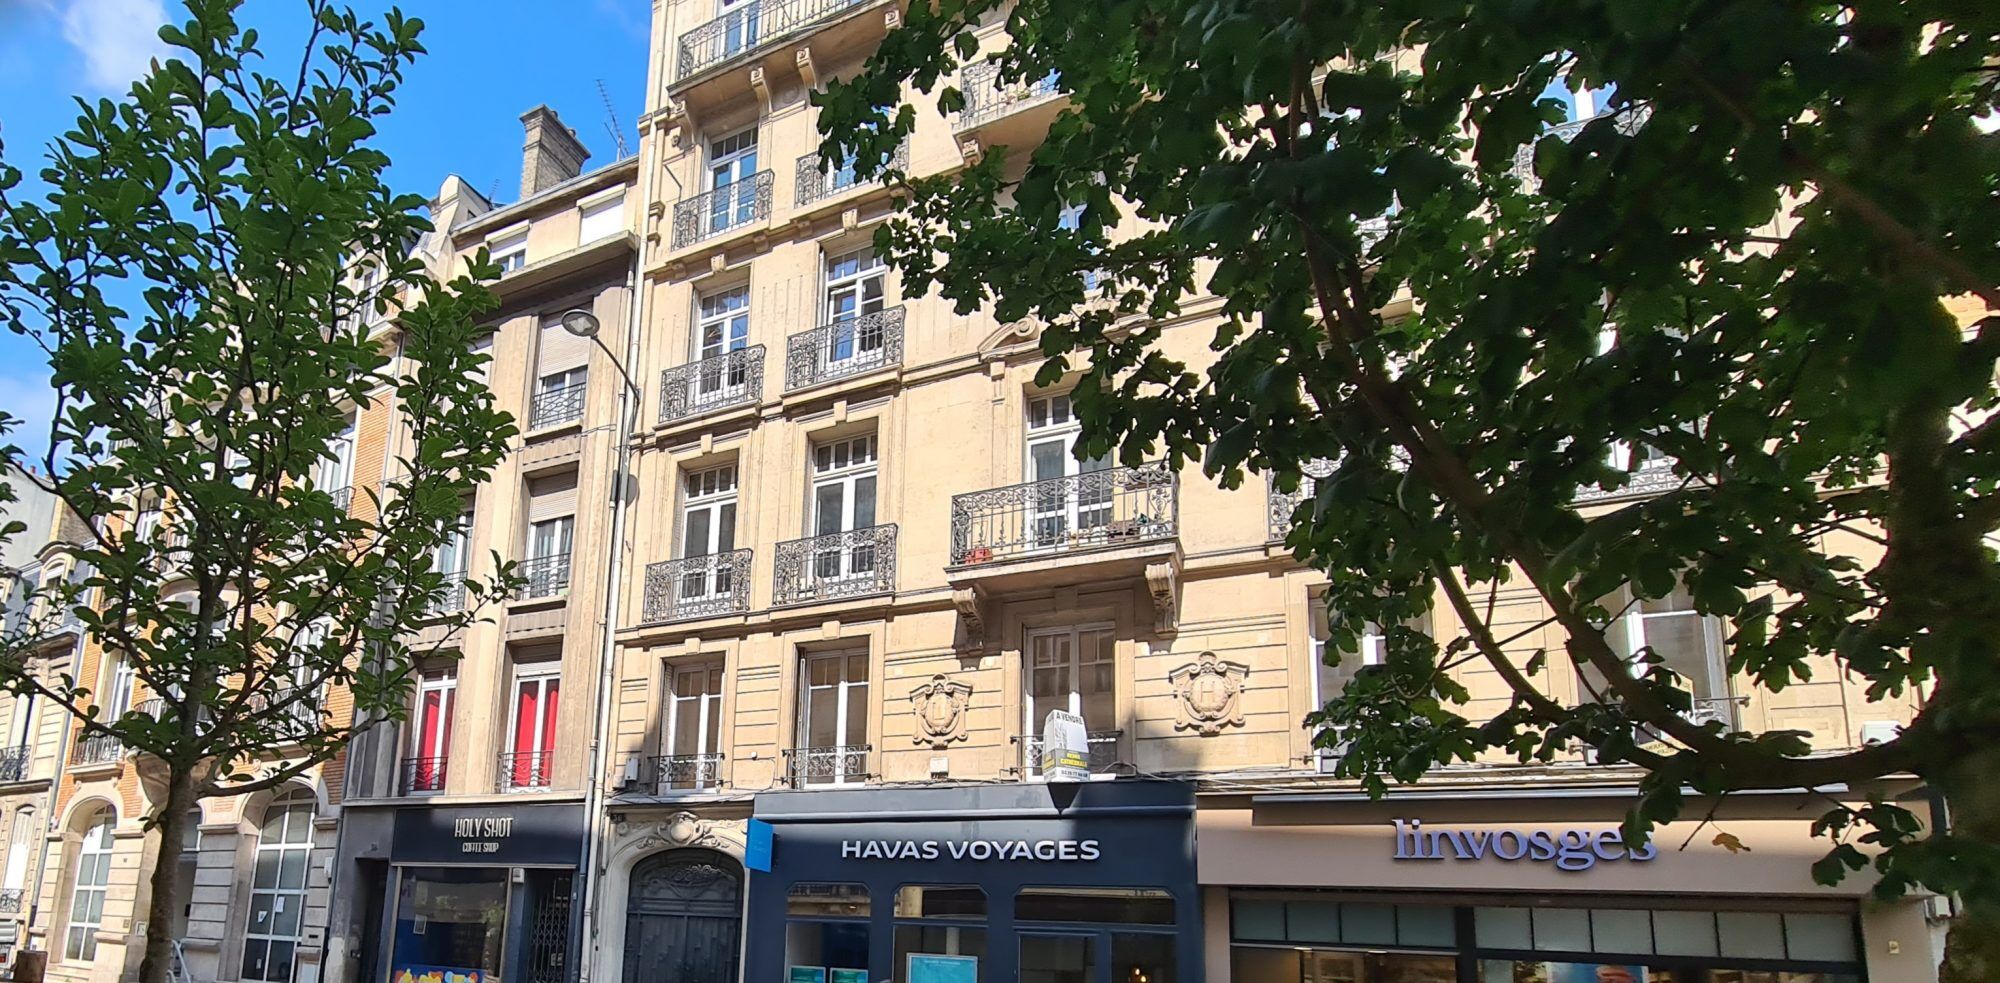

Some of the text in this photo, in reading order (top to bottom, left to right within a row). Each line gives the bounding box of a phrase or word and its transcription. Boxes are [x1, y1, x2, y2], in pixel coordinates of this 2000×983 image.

[1062, 714, 1082, 724] VENDRE
[454, 817, 513, 837] HOLY SHOT
[462, 842, 499, 853] COFFEE SHOP
[842, 839, 1100, 861] HAVAS VOYAGES
[1391, 818, 1657, 871] linvosges
